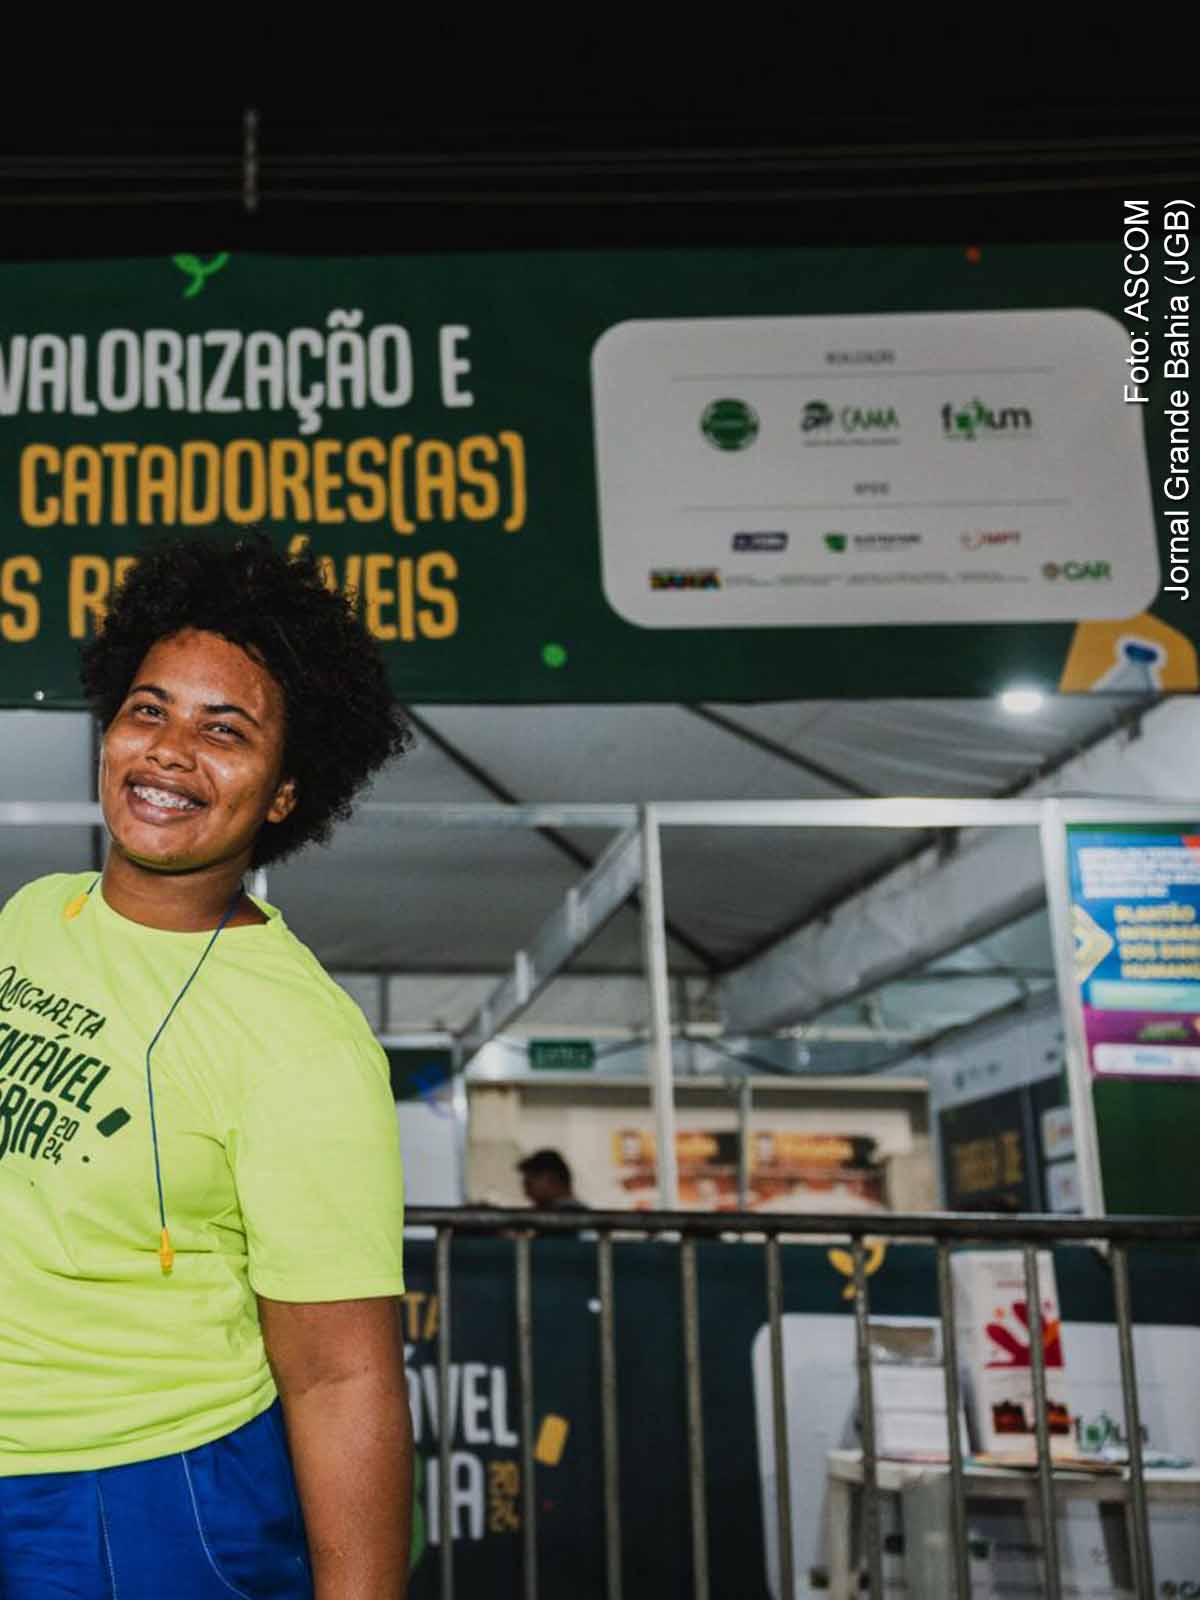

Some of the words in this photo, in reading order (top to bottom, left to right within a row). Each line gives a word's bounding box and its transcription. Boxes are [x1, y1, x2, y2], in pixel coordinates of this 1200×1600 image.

[439, 325, 474, 408] E
[19, 431, 527, 534] CATADORES(AS)
[41, 1137, 63, 1165] 24
[52, 1116, 80, 1142] 20
